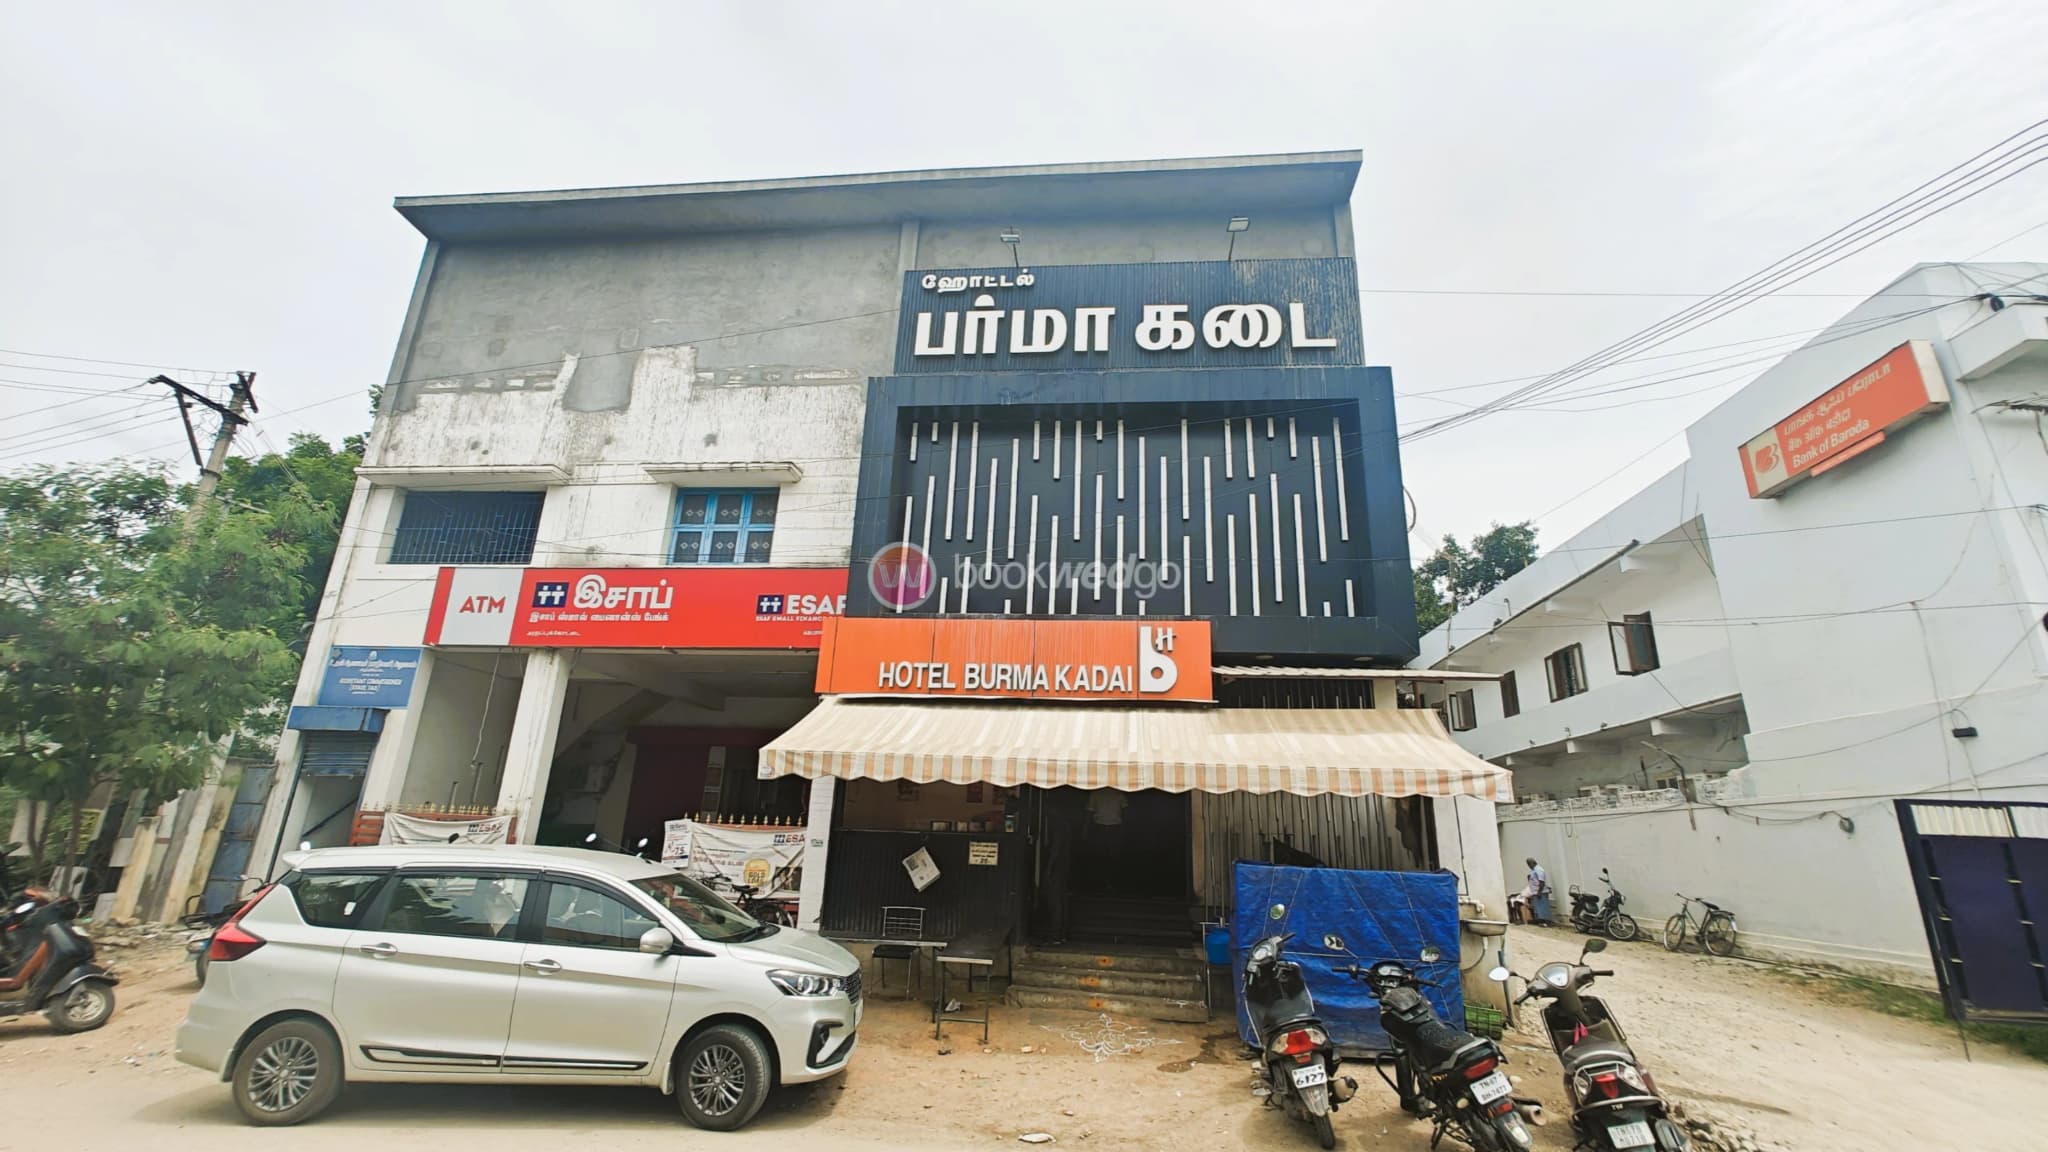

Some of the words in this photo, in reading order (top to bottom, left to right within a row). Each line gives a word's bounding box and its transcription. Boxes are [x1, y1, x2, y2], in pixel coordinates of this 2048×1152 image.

[921, 268, 1036, 293] ஹோட்டல்
[913, 293, 1116, 356] பர்மா
[1134, 301, 1337, 351] கடை
[1792, 445, 1816, 468] Bank
[1819, 439, 1828, 453] of
[1830, 419, 1869, 447] Baroda
[458, 594, 507, 615] ATM
[573, 573, 674, 609] இசாப்
[786, 593, 848, 615] ESAF
[878, 661, 956, 689] HOTEL
[963, 662, 1051, 691] BURMA
[1054, 664, 1134, 693] KADAI
